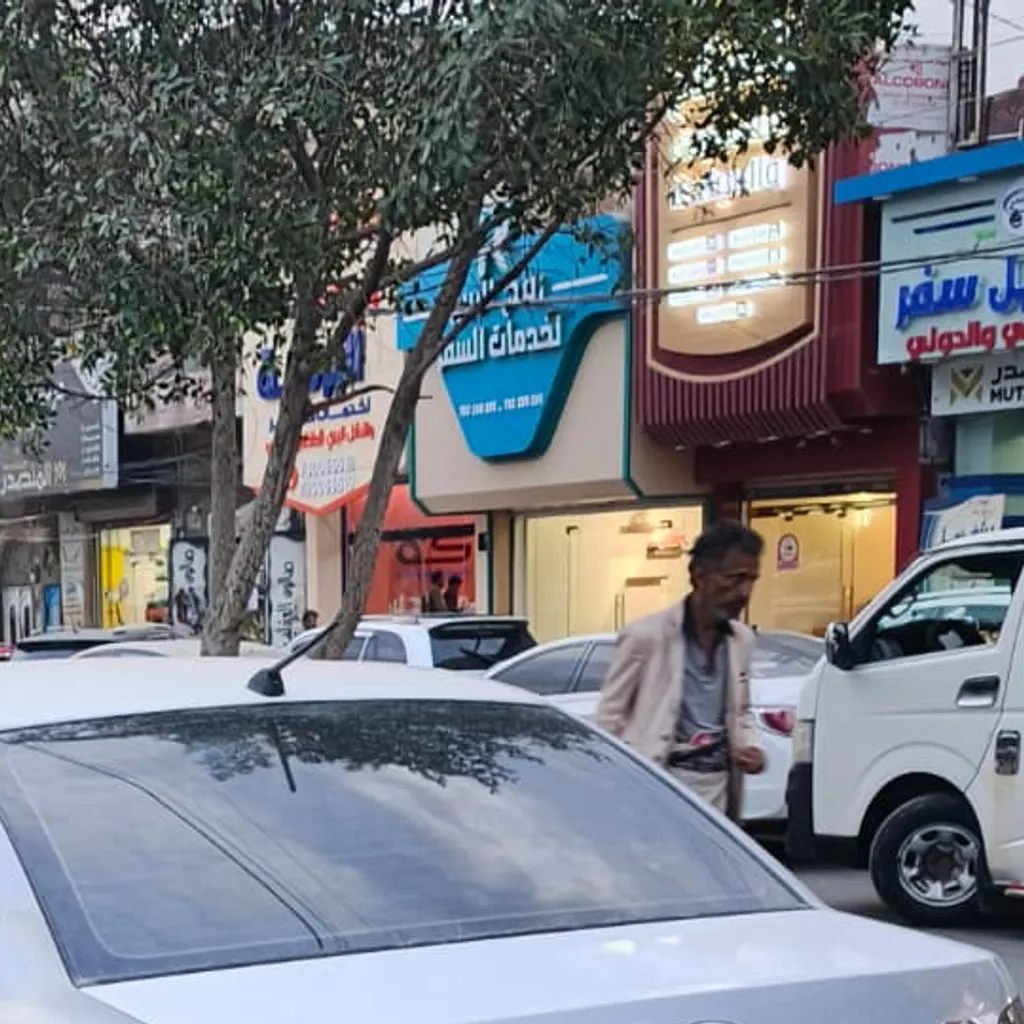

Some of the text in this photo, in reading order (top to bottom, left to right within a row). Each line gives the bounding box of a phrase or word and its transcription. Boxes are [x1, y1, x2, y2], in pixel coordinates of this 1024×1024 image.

[895, 263, 980, 333] سفر
[487, 312, 562, 358] لخدمات
[905, 319, 998, 360] والدولي
